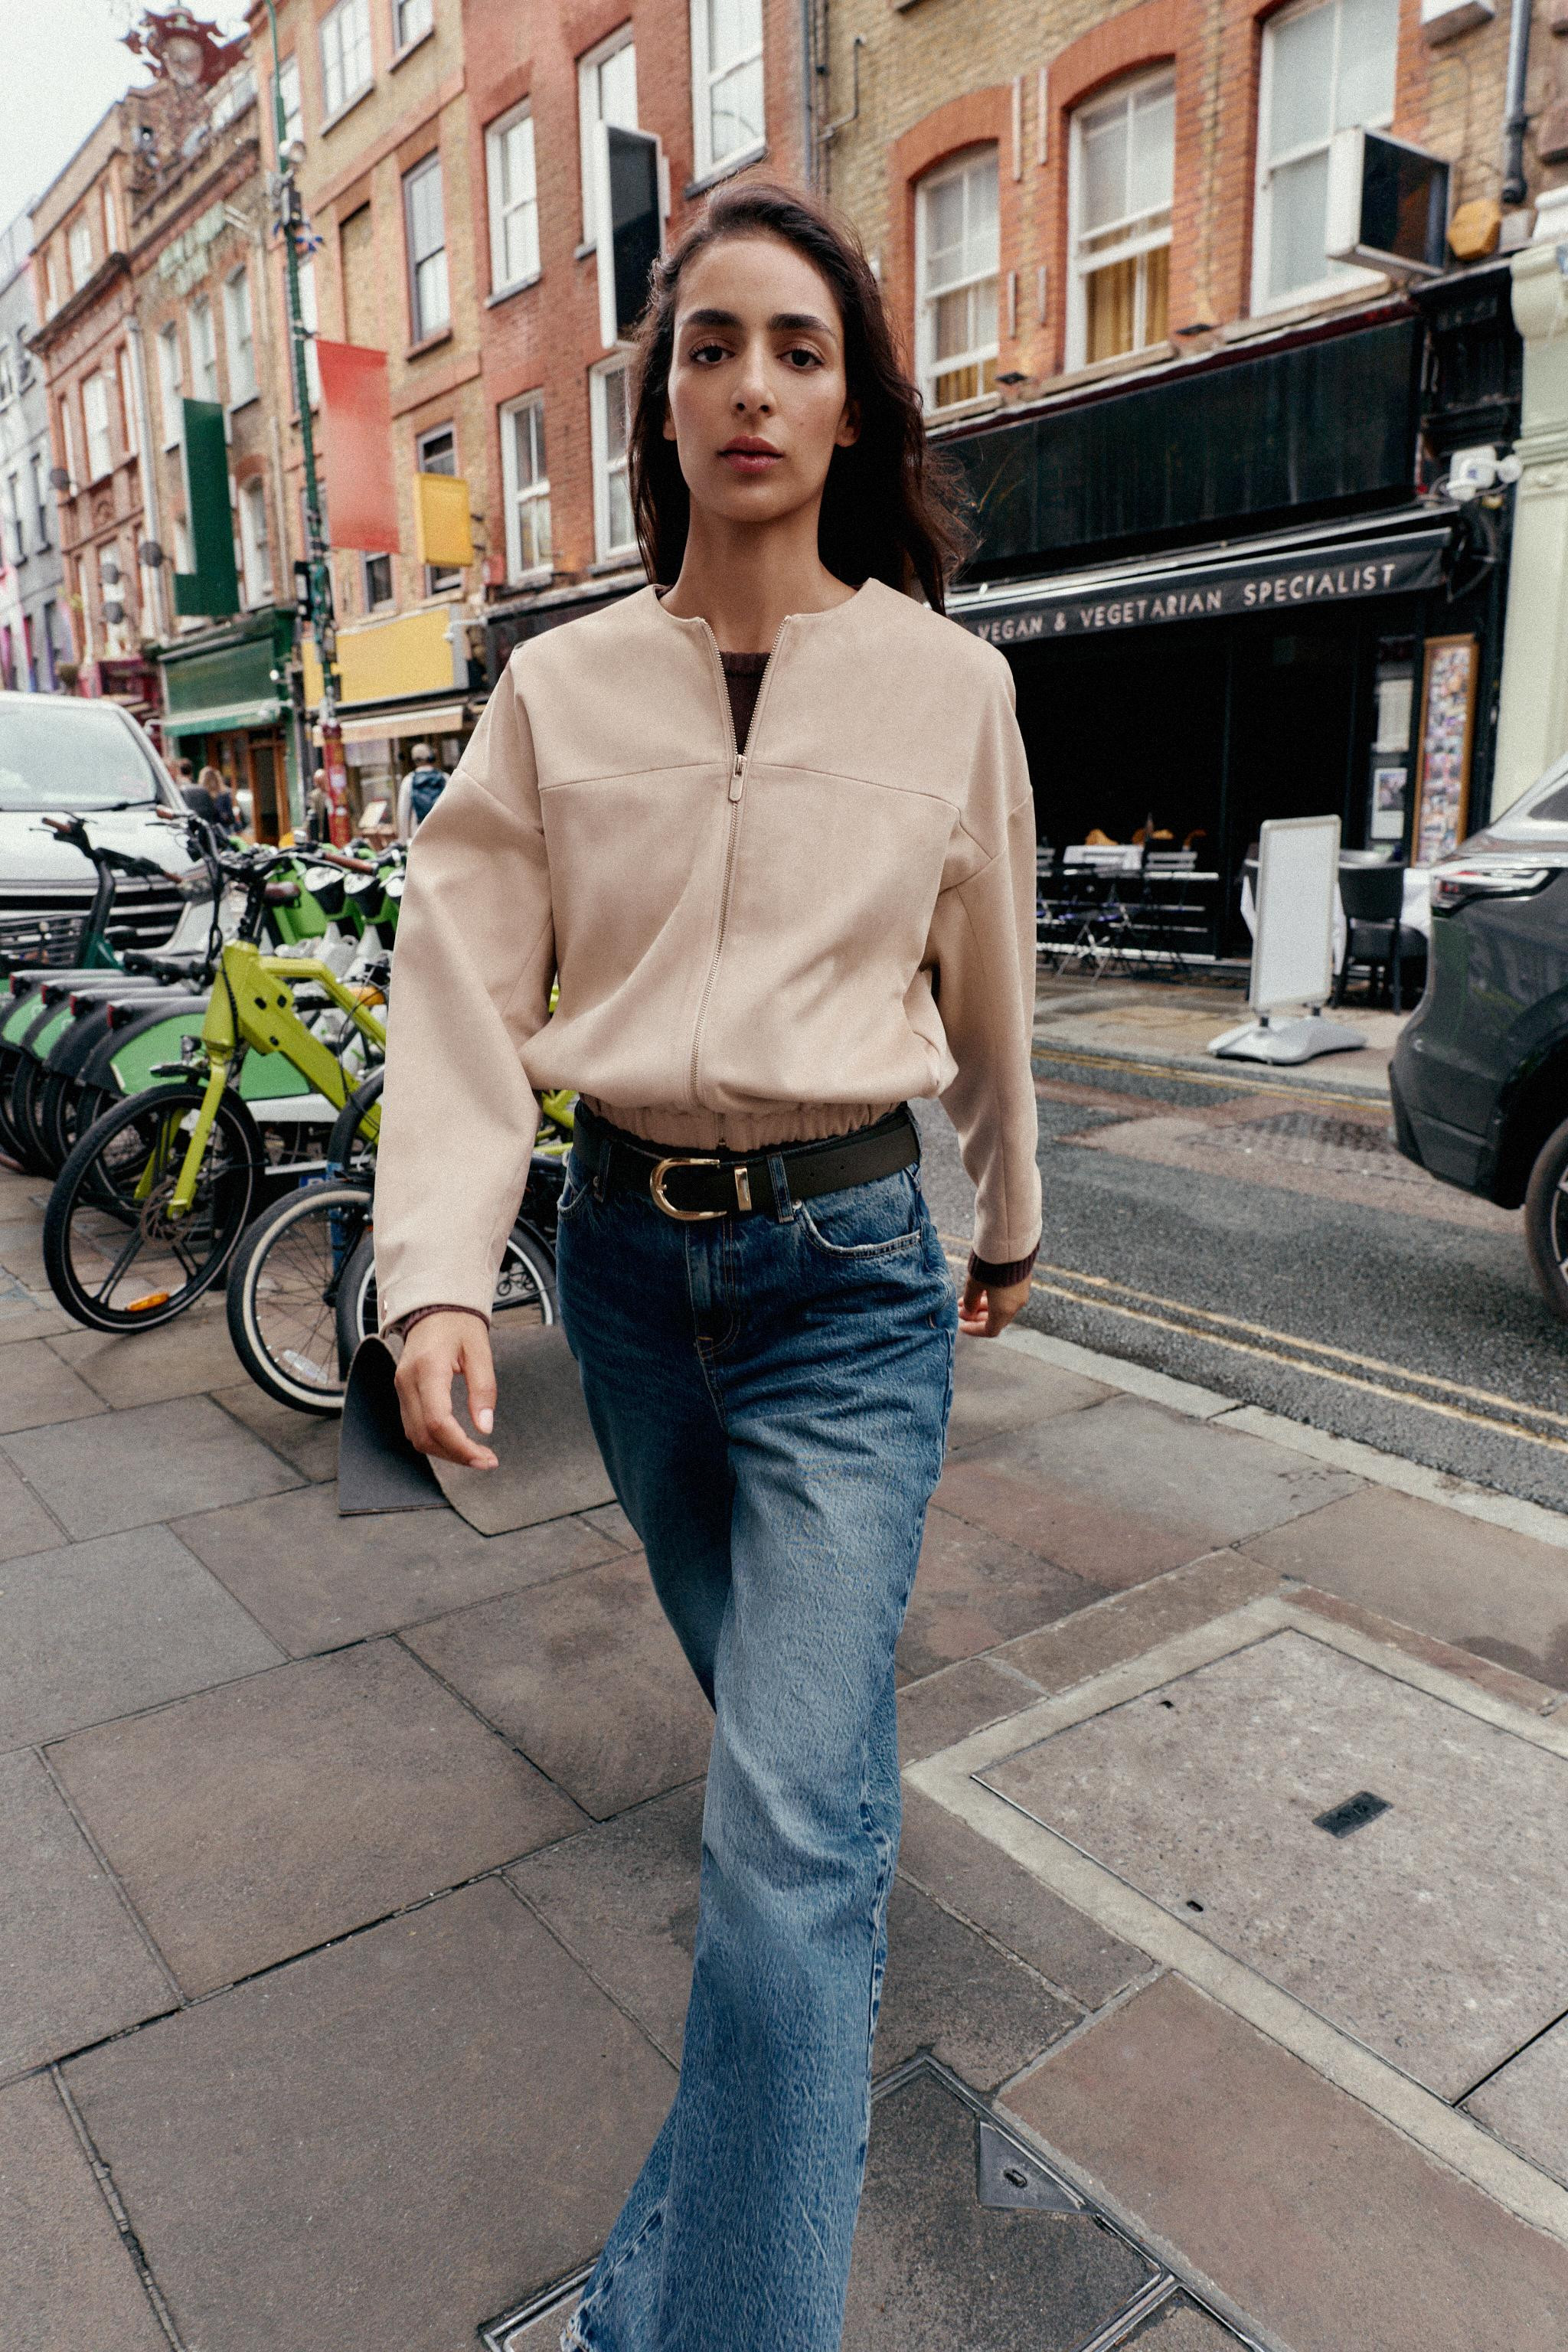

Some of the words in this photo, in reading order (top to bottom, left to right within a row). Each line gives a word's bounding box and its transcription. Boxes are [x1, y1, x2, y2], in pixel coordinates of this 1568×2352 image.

[978, 615, 1043, 641] VEGAN
[1054, 612, 1066, 632] &
[1080, 589, 1222, 628] VEGETARIAN
[1243, 563, 1396, 606] SPECIALIST
